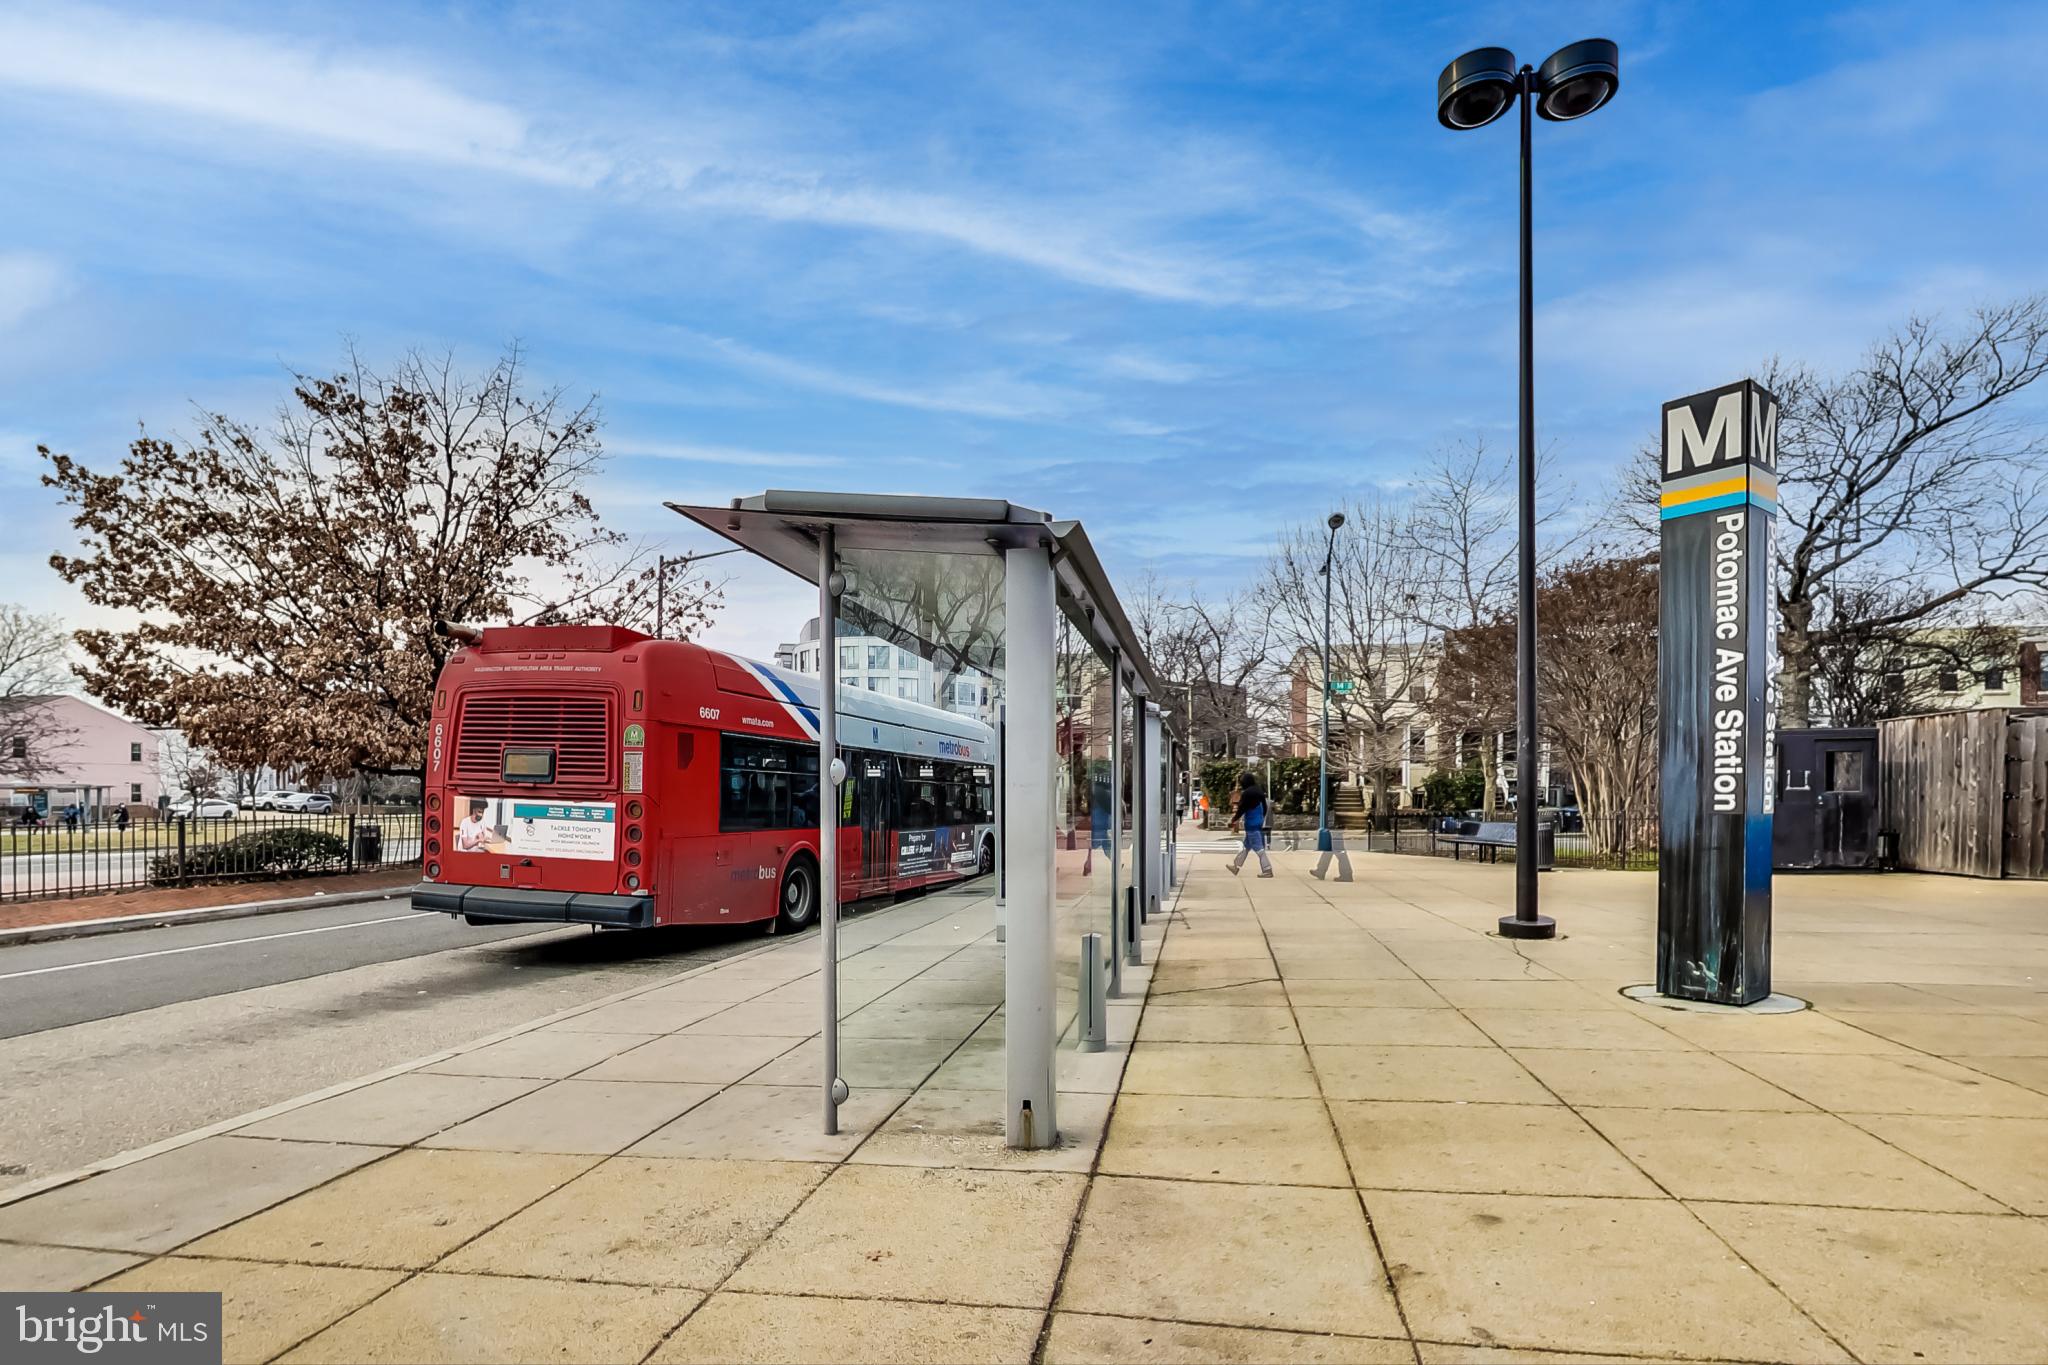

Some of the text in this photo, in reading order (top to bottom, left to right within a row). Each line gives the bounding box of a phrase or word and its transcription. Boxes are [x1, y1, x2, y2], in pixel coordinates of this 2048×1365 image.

[1667, 390, 1742, 474] M
[1750, 391, 1777, 470] M
[1766, 520, 1777, 642] Potomac
[1713, 512, 1745, 811] Potomac Ave Station
[433, 723, 443, 772] 6607
[699, 706, 720, 721] 6607
[742, 717, 774, 728] wmata.com
[938, 740, 970, 757] metrobus
[1764, 711, 1776, 812] Station
